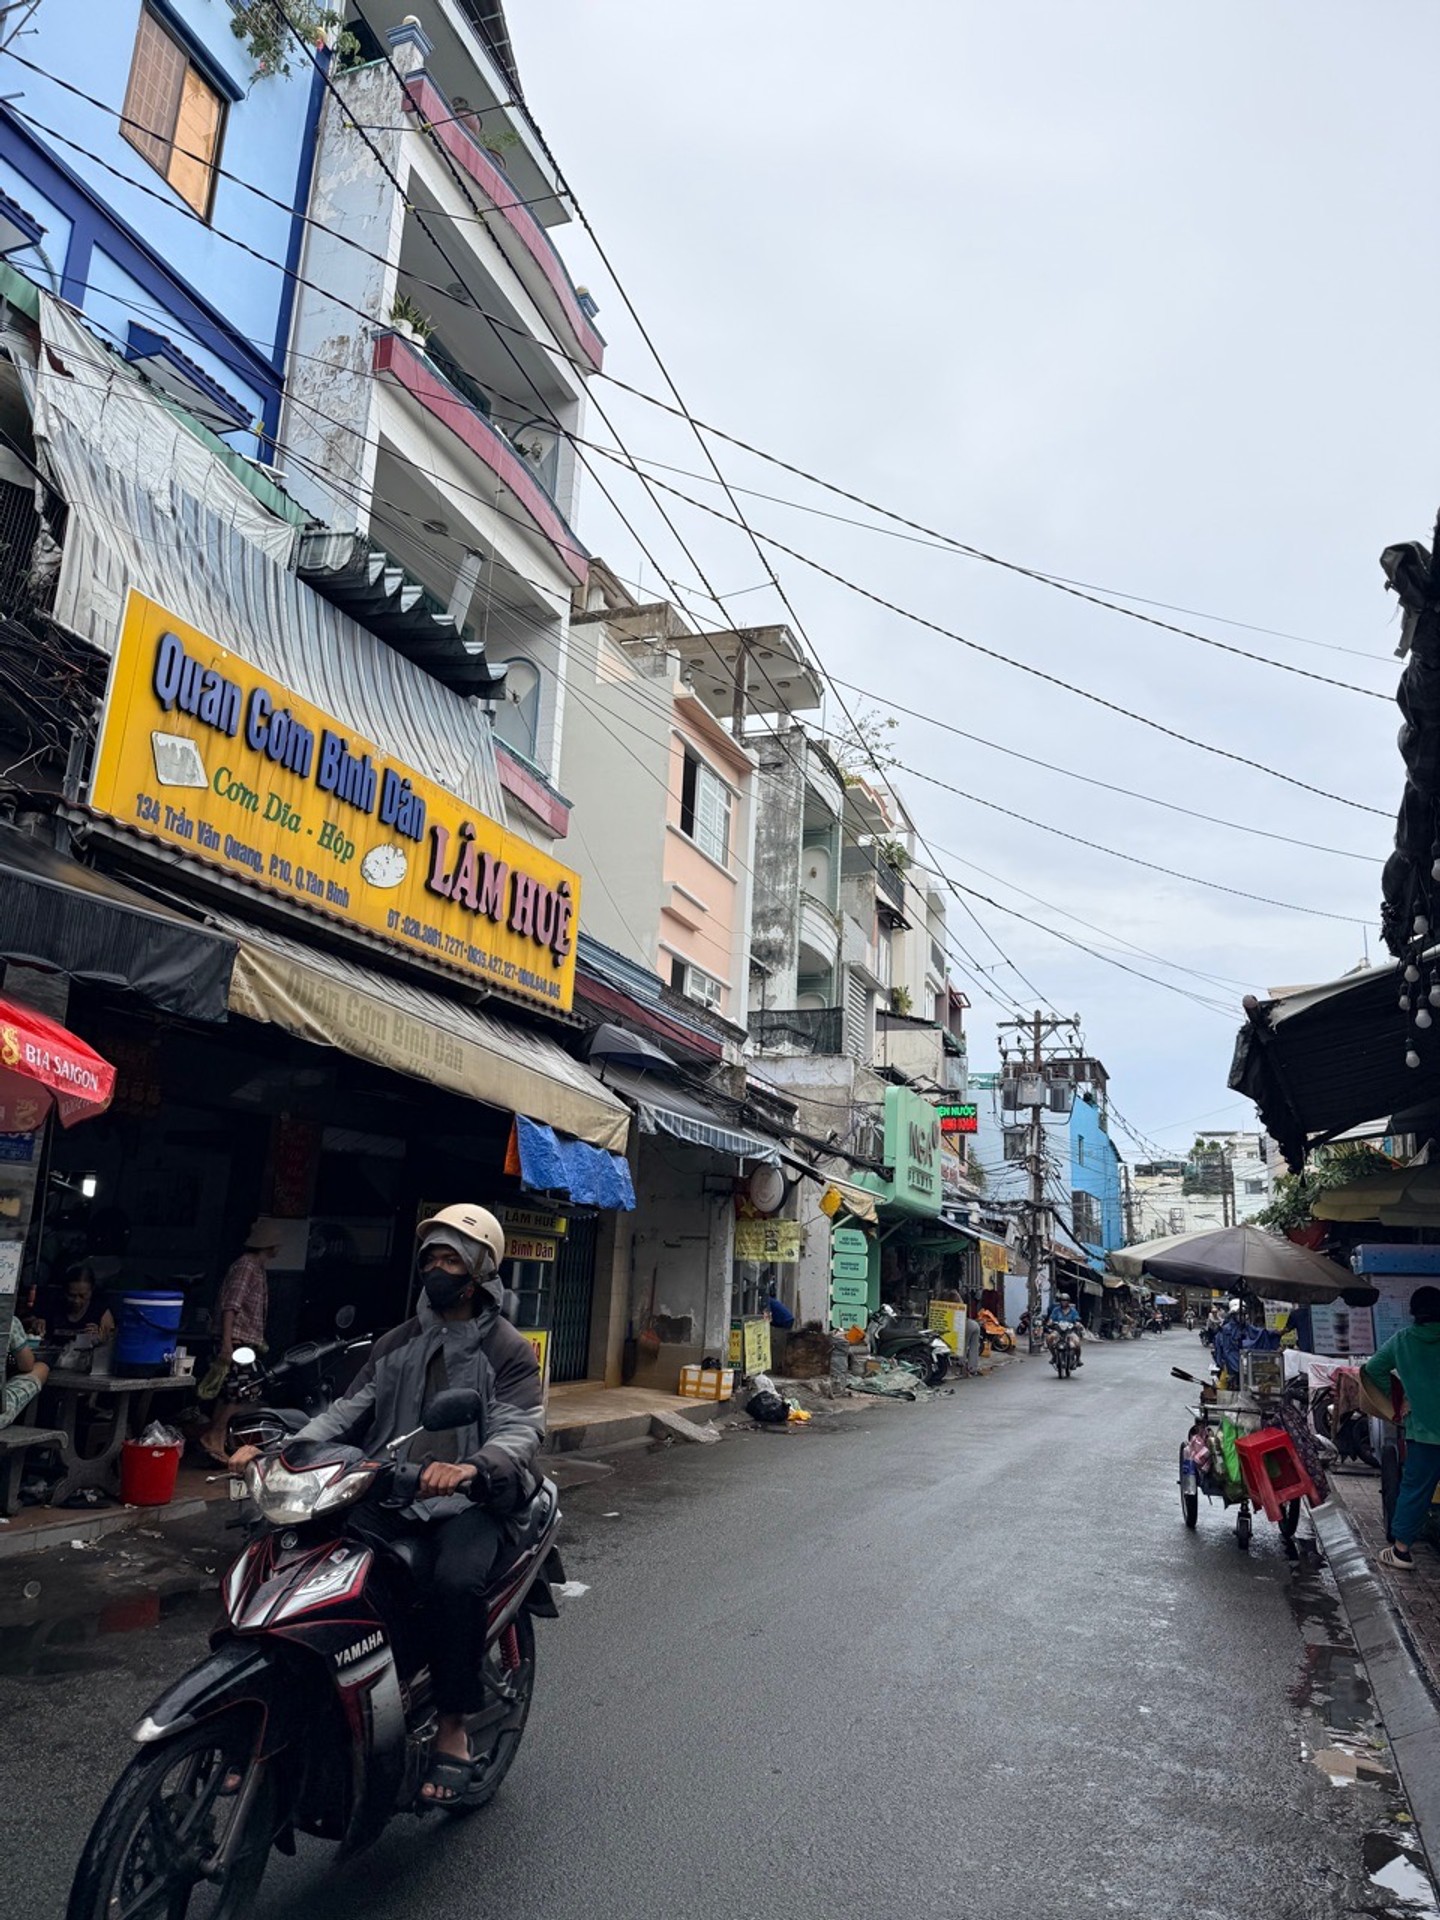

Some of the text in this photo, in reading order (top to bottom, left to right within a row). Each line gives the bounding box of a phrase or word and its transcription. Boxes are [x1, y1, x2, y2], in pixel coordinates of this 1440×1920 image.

[245, 688, 315, 778] Cơm
[316, 729, 378, 814] Bình
[379, 768, 427, 842] Dân
[136, 793, 161, 825] 134
[198, 819, 221, 852] Văn
[224, 834, 265, 874] Quang,
[213, 767, 260, 813] Cơm
[263, 792, 303, 834] Dĩa
[317, 820, 356, 864] Hộp
[424, 821, 573, 969] LÂM HUỆ
[25, 1043, 99, 1092] BIA SAIGON
[285, 966, 340, 1022] Quán
[345, 993, 388, 1042] Cơm
[391, 1011, 431, 1059] Bình
[433, 1031, 464, 1075] Dân
[334, 1629, 384, 1668] YAMAHA
